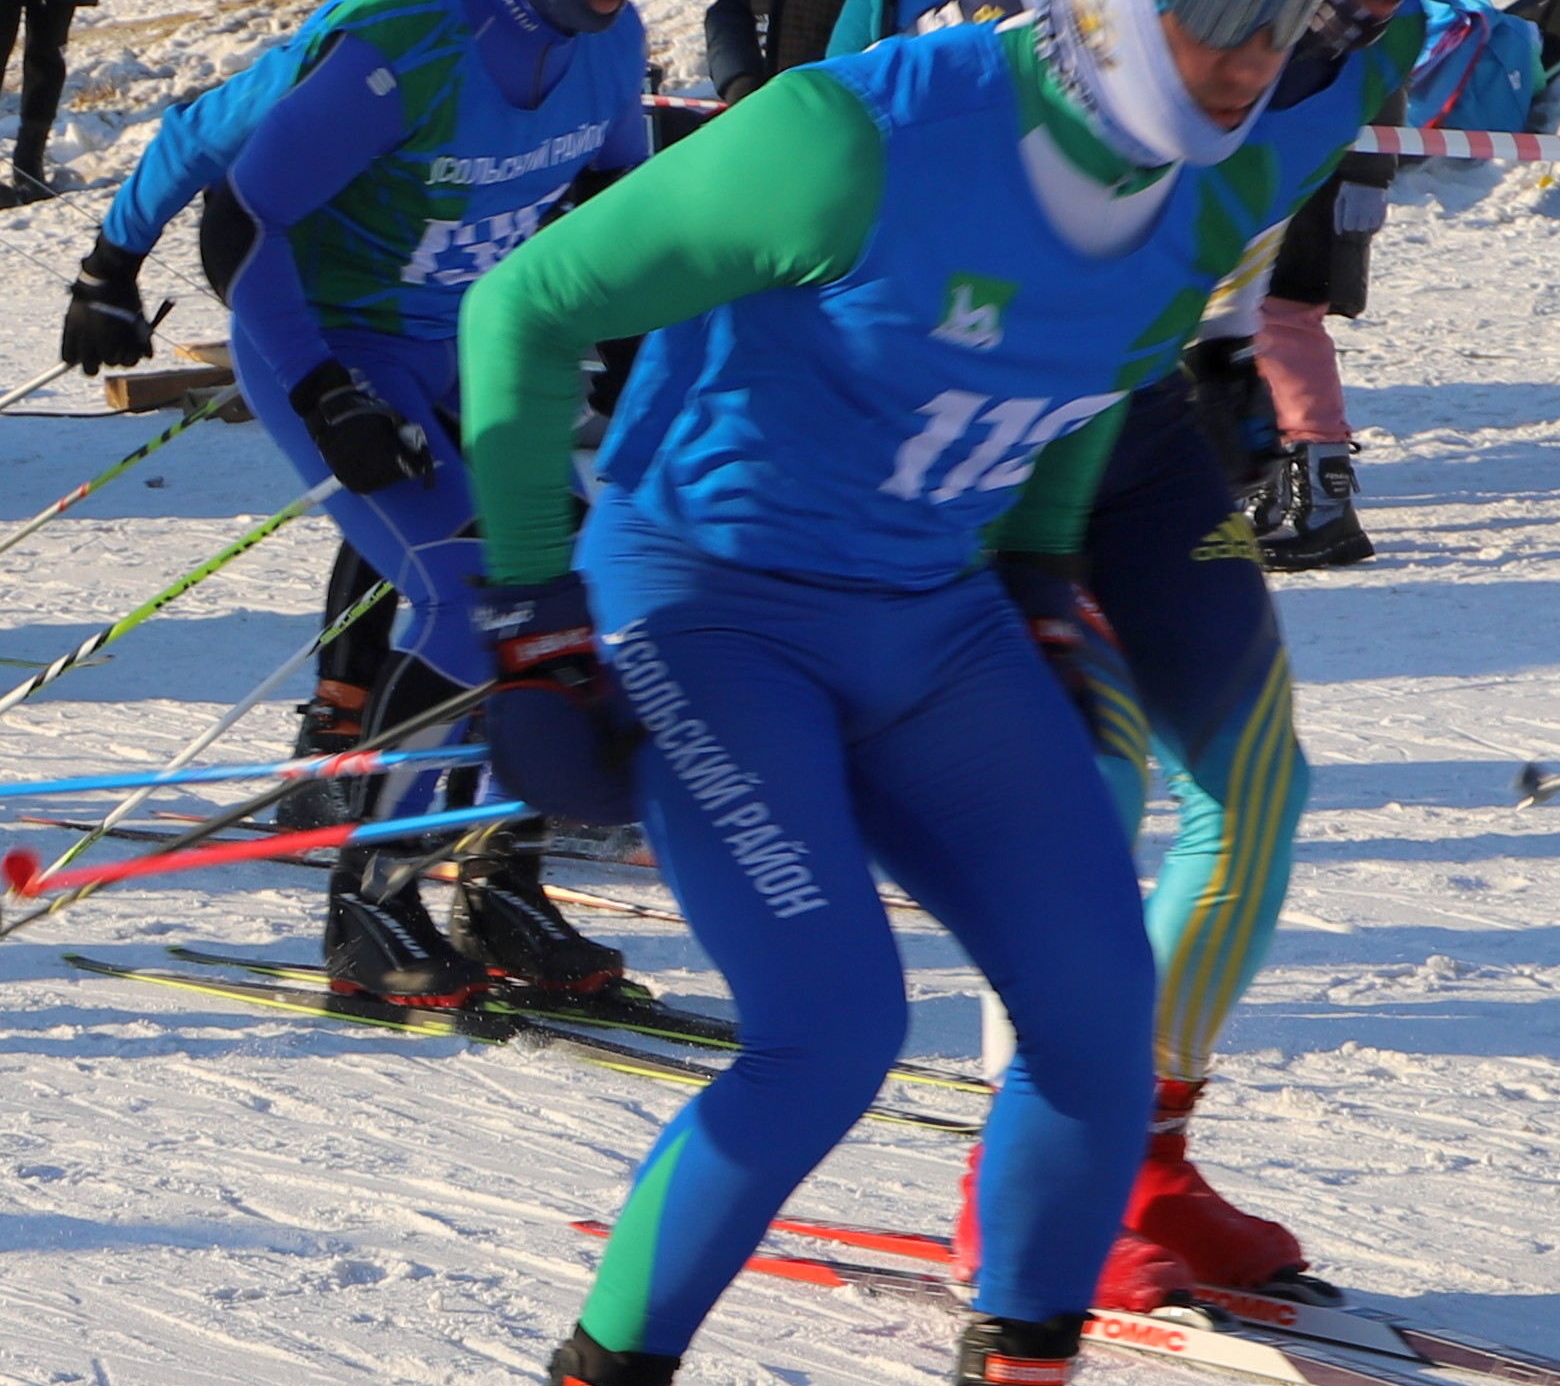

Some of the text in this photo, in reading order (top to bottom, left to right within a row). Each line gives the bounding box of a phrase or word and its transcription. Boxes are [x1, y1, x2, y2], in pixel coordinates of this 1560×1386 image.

[602, 616, 831, 919] УСОЛЬСКИЙ РАЙОН
[1081, 1313, 1188, 1352] TOMIC
